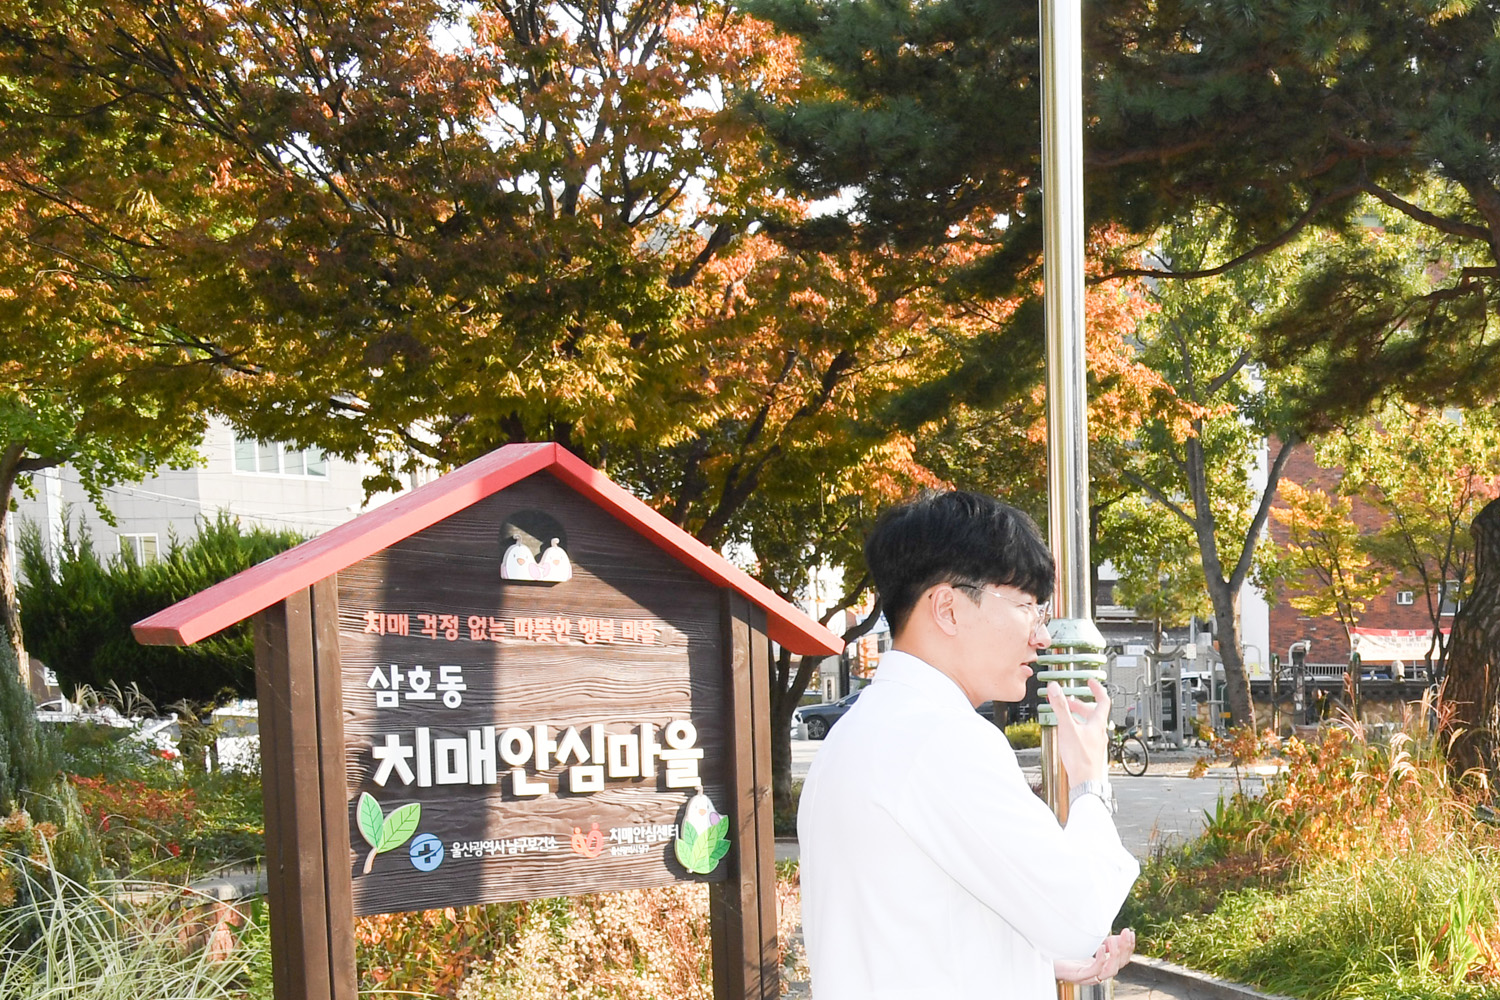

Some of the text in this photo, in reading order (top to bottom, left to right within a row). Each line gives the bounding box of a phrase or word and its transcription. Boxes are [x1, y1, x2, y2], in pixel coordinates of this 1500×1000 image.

[362, 611, 656, 644] 치매 걱정 없는 따뜻한 행복 마을
[366, 664, 468, 709] 삼호동
[372, 719, 704, 796] 치매안심마을
[449, 835, 560, 859] 울산광역시 남구보건소
[609, 823, 680, 845] 치매안심센터
